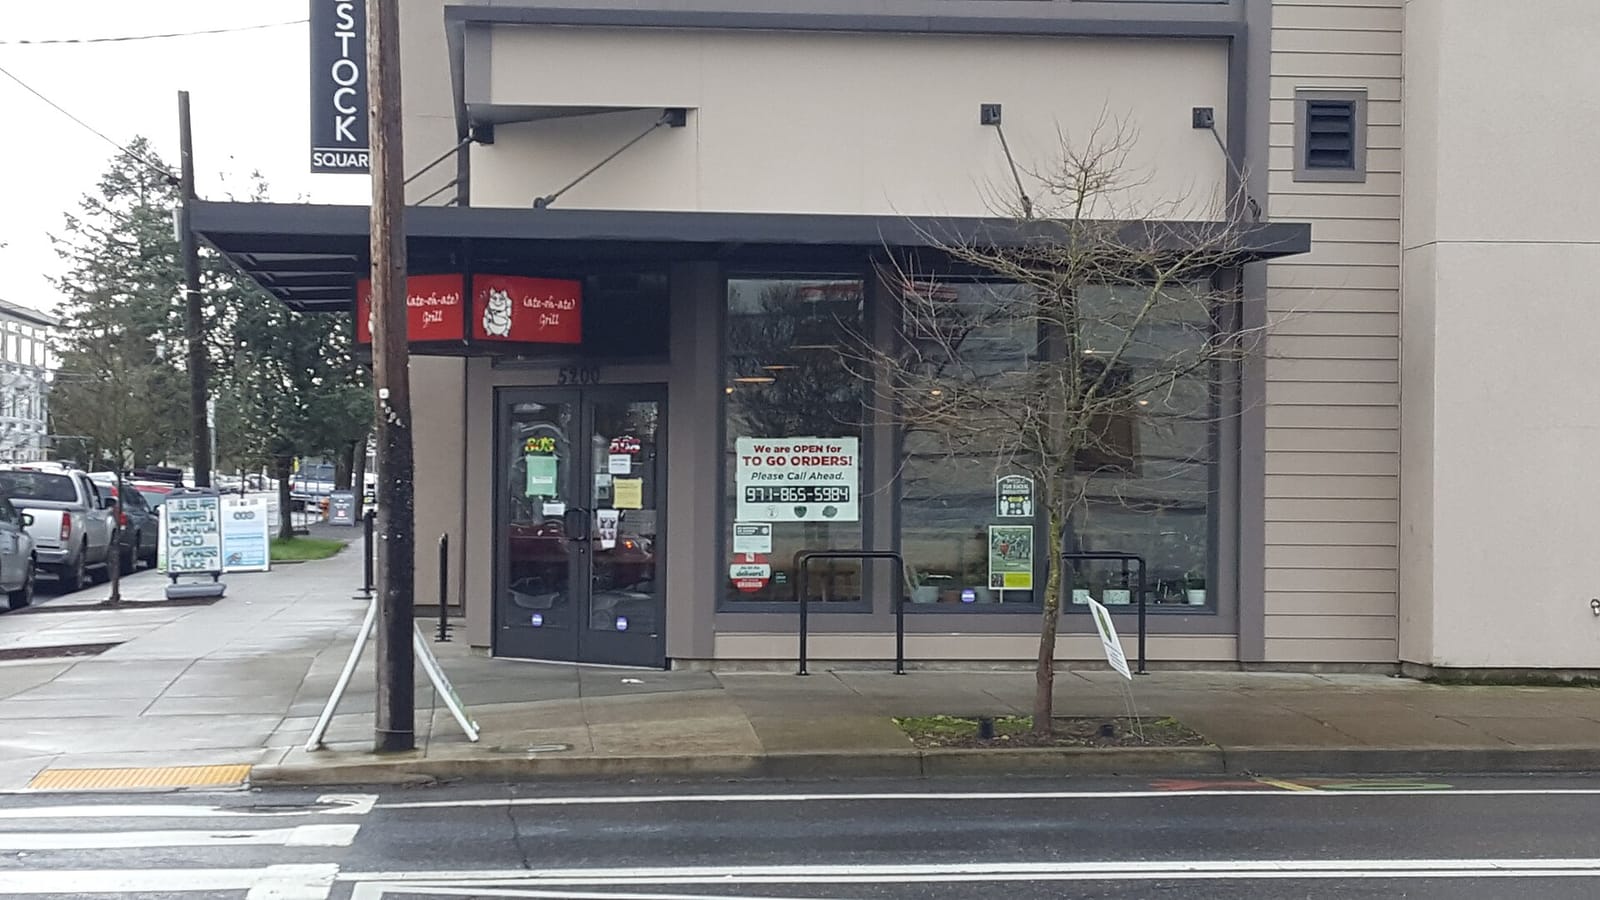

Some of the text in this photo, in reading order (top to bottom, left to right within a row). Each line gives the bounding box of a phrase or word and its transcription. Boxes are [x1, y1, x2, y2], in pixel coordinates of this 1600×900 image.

[332, 0, 359, 142] STOCK
[313, 152, 369, 167] SQUAR
[422, 310, 443, 328] Grill
[539, 313, 559, 331] Grill
[557, 367, 601, 386] 5200
[753, 445, 771, 453] We
[793, 445, 823, 453] OPEN
[826, 445, 842, 453] for
[742, 456, 853, 466] TO GO ORDERS!
[751, 472, 845, 480] Please Call Ahead.
[746, 487, 849, 501] 971-865-5984
[170, 535, 204, 547] CBD
